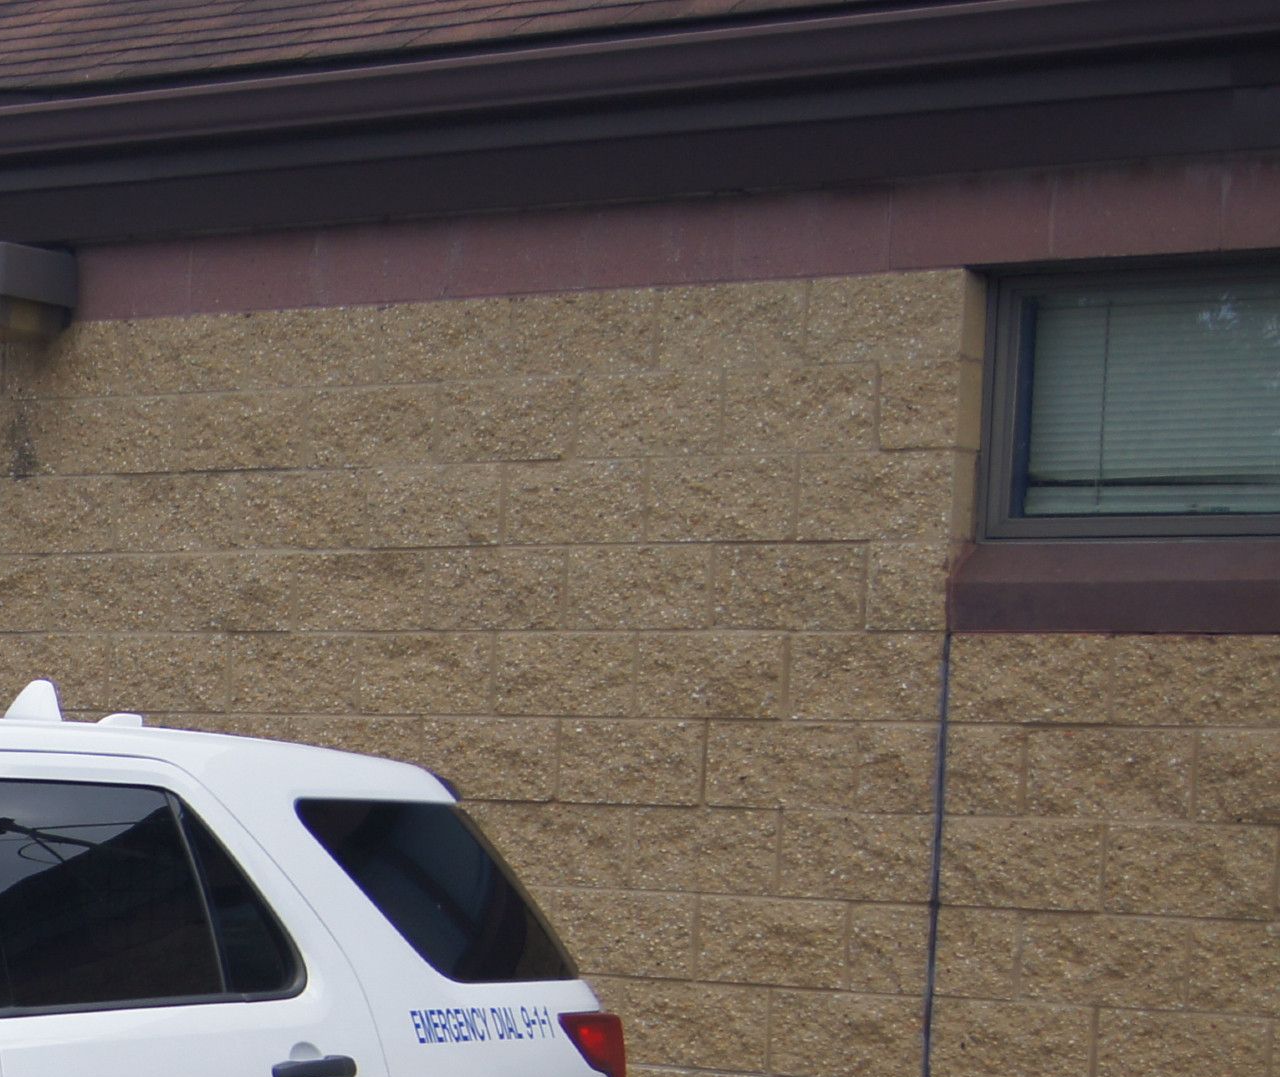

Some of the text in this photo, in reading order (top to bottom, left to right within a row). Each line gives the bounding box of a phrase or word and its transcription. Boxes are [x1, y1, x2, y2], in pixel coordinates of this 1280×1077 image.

[410, 1005, 555, 1044] EMERGENCY DIAL 9-1-1
